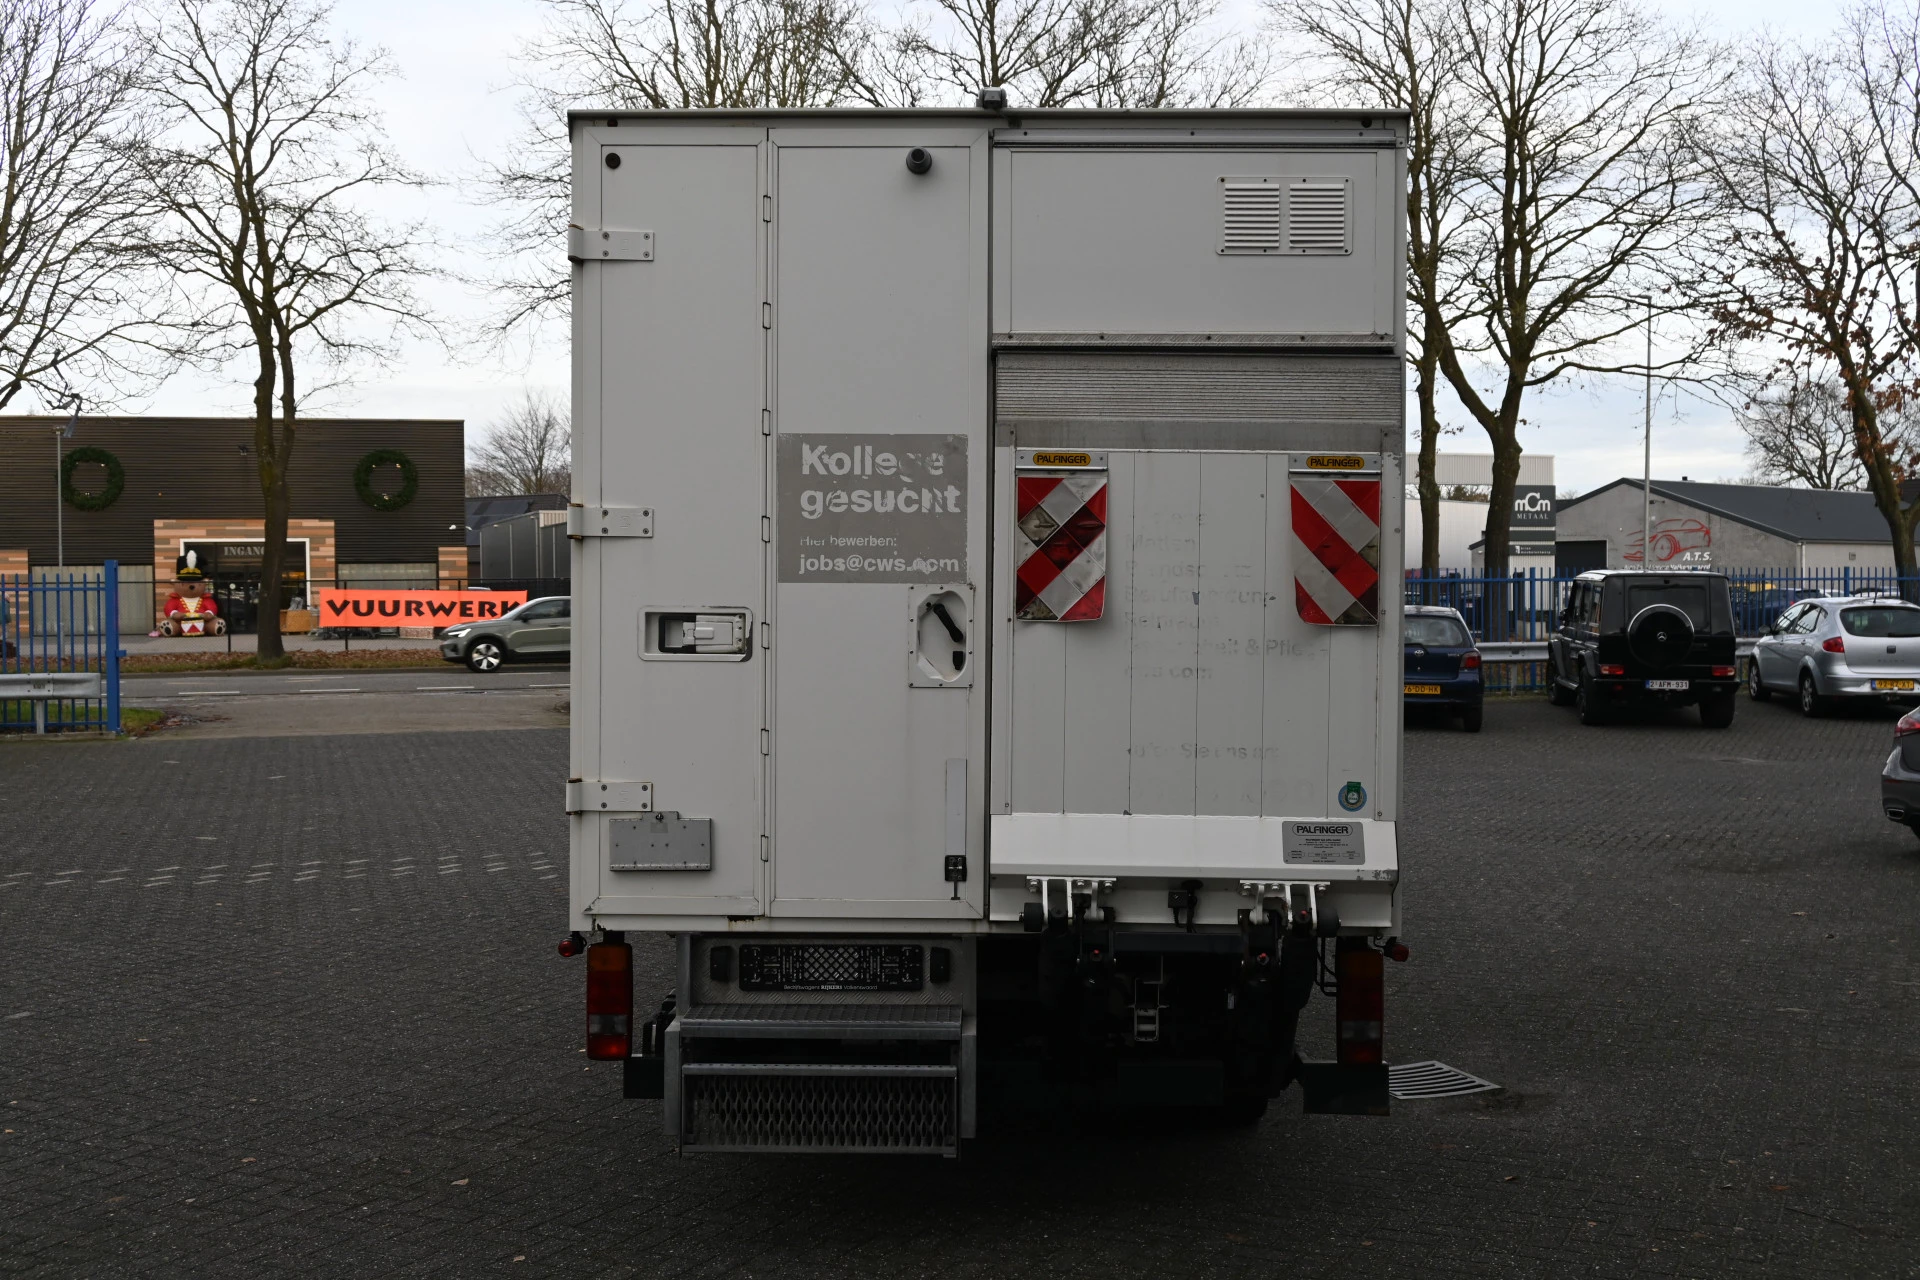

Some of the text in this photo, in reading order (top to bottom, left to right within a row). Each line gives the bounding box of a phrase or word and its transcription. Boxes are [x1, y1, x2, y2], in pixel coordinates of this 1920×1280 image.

[1037, 455, 1087, 464] PALFINGER
[1310, 458, 1361, 467] PALFINGER
[223, 546, 265, 556] INGAN
[1682, 551, 1712, 561] A.T.S.
[1296, 825, 1349, 834] PALFINGER
